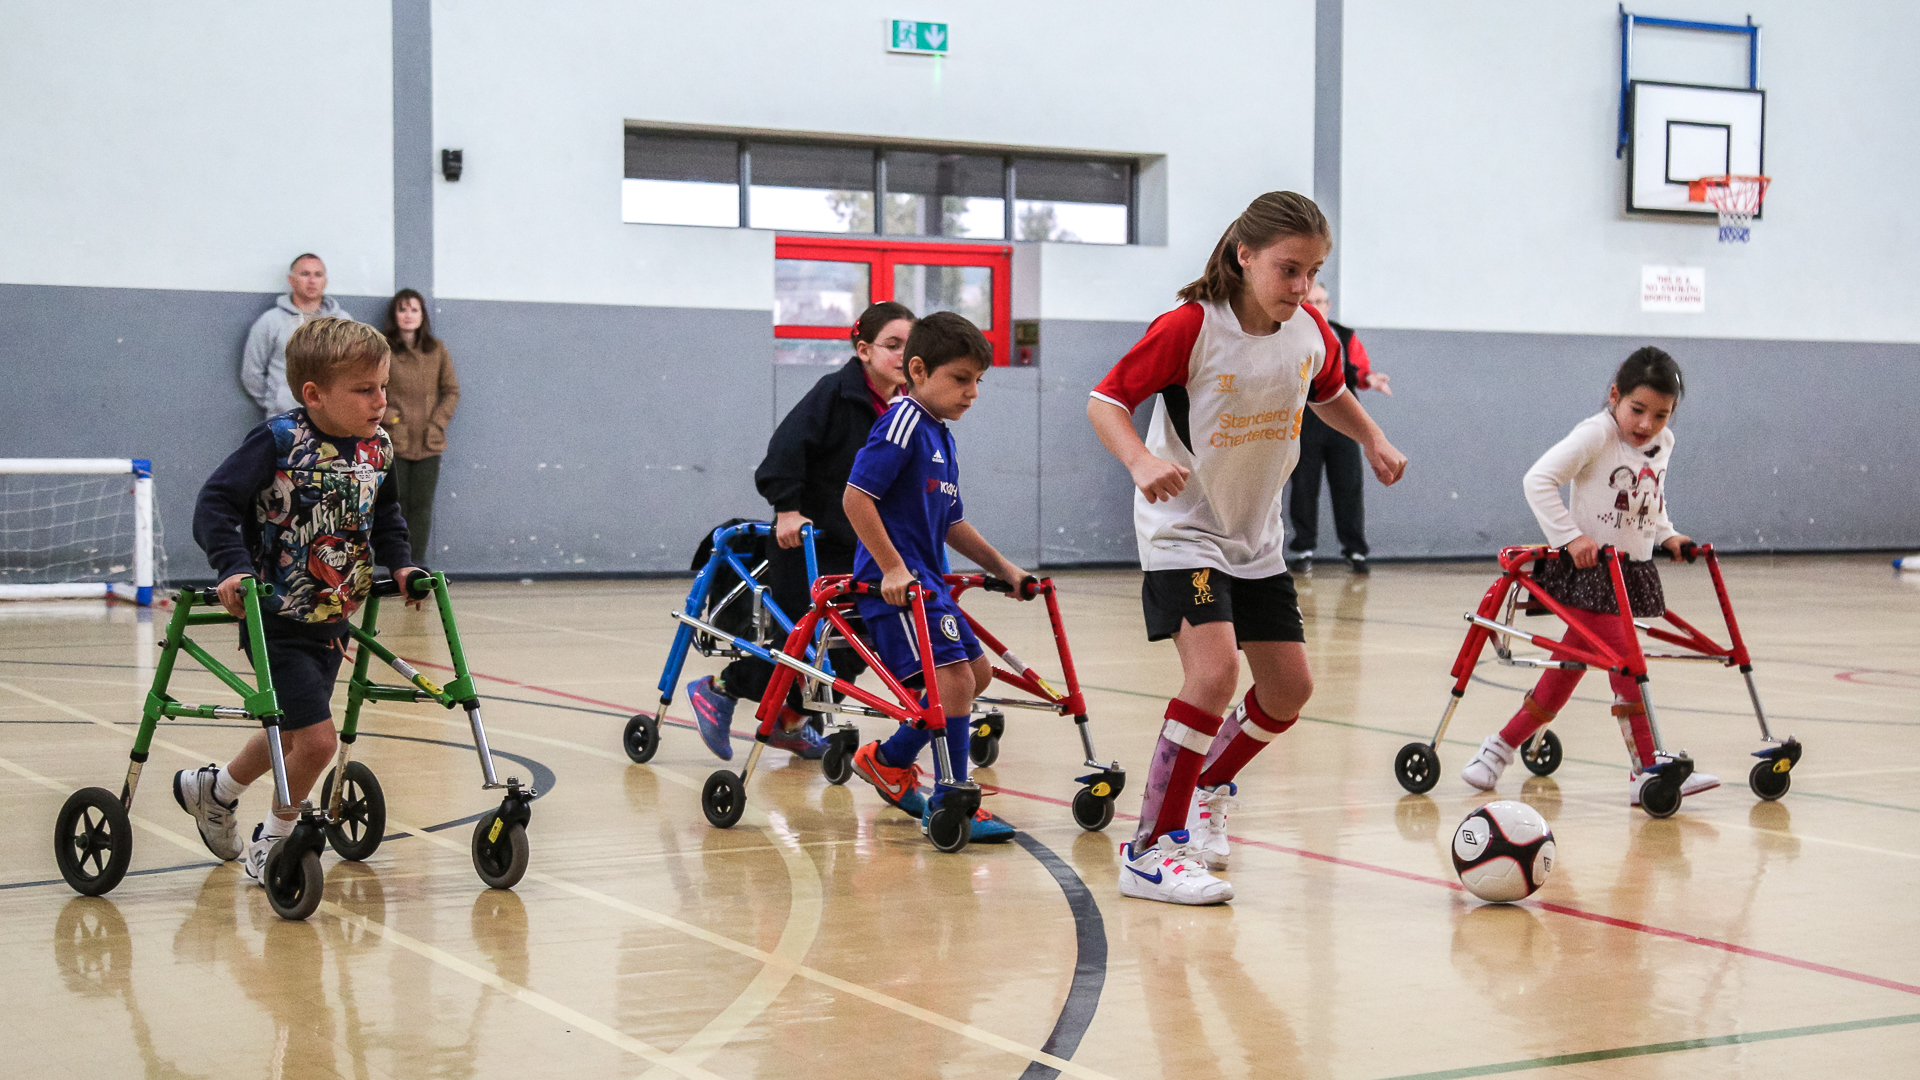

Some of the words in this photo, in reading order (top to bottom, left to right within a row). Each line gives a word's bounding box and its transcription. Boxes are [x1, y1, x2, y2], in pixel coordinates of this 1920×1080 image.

[1645, 284, 1658, 292] NO
[1219, 408, 1290, 429] Standard
[1210, 427, 1288, 447] Chartered
[290, 498, 346, 548] SMASH!
[1194, 594, 1214, 605] LFC
